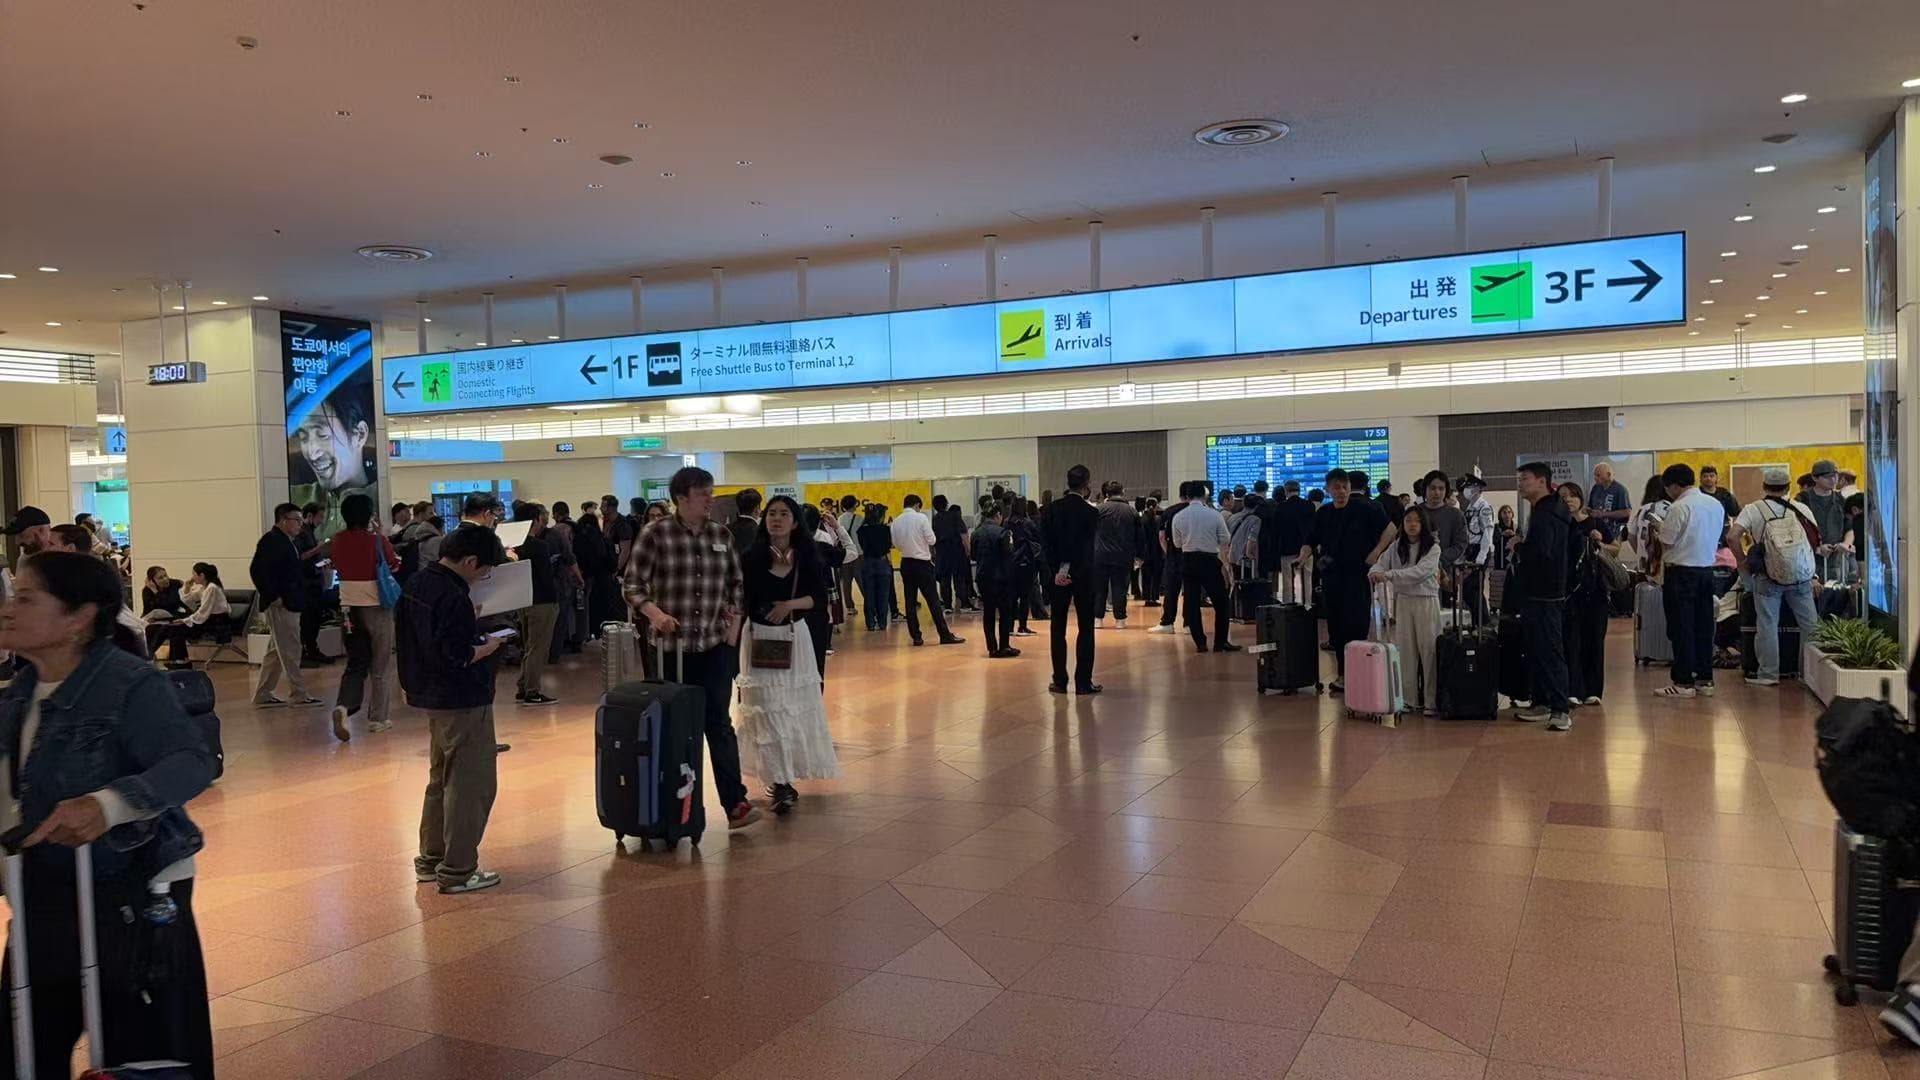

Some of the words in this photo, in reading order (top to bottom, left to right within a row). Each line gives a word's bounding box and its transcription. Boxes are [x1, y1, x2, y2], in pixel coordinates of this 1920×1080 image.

[1410, 276, 1457, 300] 出発
[1544, 268, 1596, 304] 3F
[1054, 310, 1092, 331] 到着
[1360, 306, 1457, 327] Departures
[291, 337, 351, 357] 도쿄에서의
[691, 336, 836, 361] ターミナル間無料連絡バス
[1055, 333, 1112, 351] Arrivals
[292, 357, 328, 375] 편안한
[612, 354, 639, 380] 1F
[690, 367, 713, 378] Free
[714, 363, 752, 376] Shuttle
[754, 362, 772, 373] Bus
[774, 361, 786, 372] to
[789, 357, 836, 371] Terminal
[838, 355, 854, 370] 1,2
[293, 377, 319, 394] 이동
[457, 377, 496, 389] Domestic
[458, 388, 505, 400] Connecting
[506, 385, 536, 398] Flights
[1217, 437, 1242, 445] Arrivals
